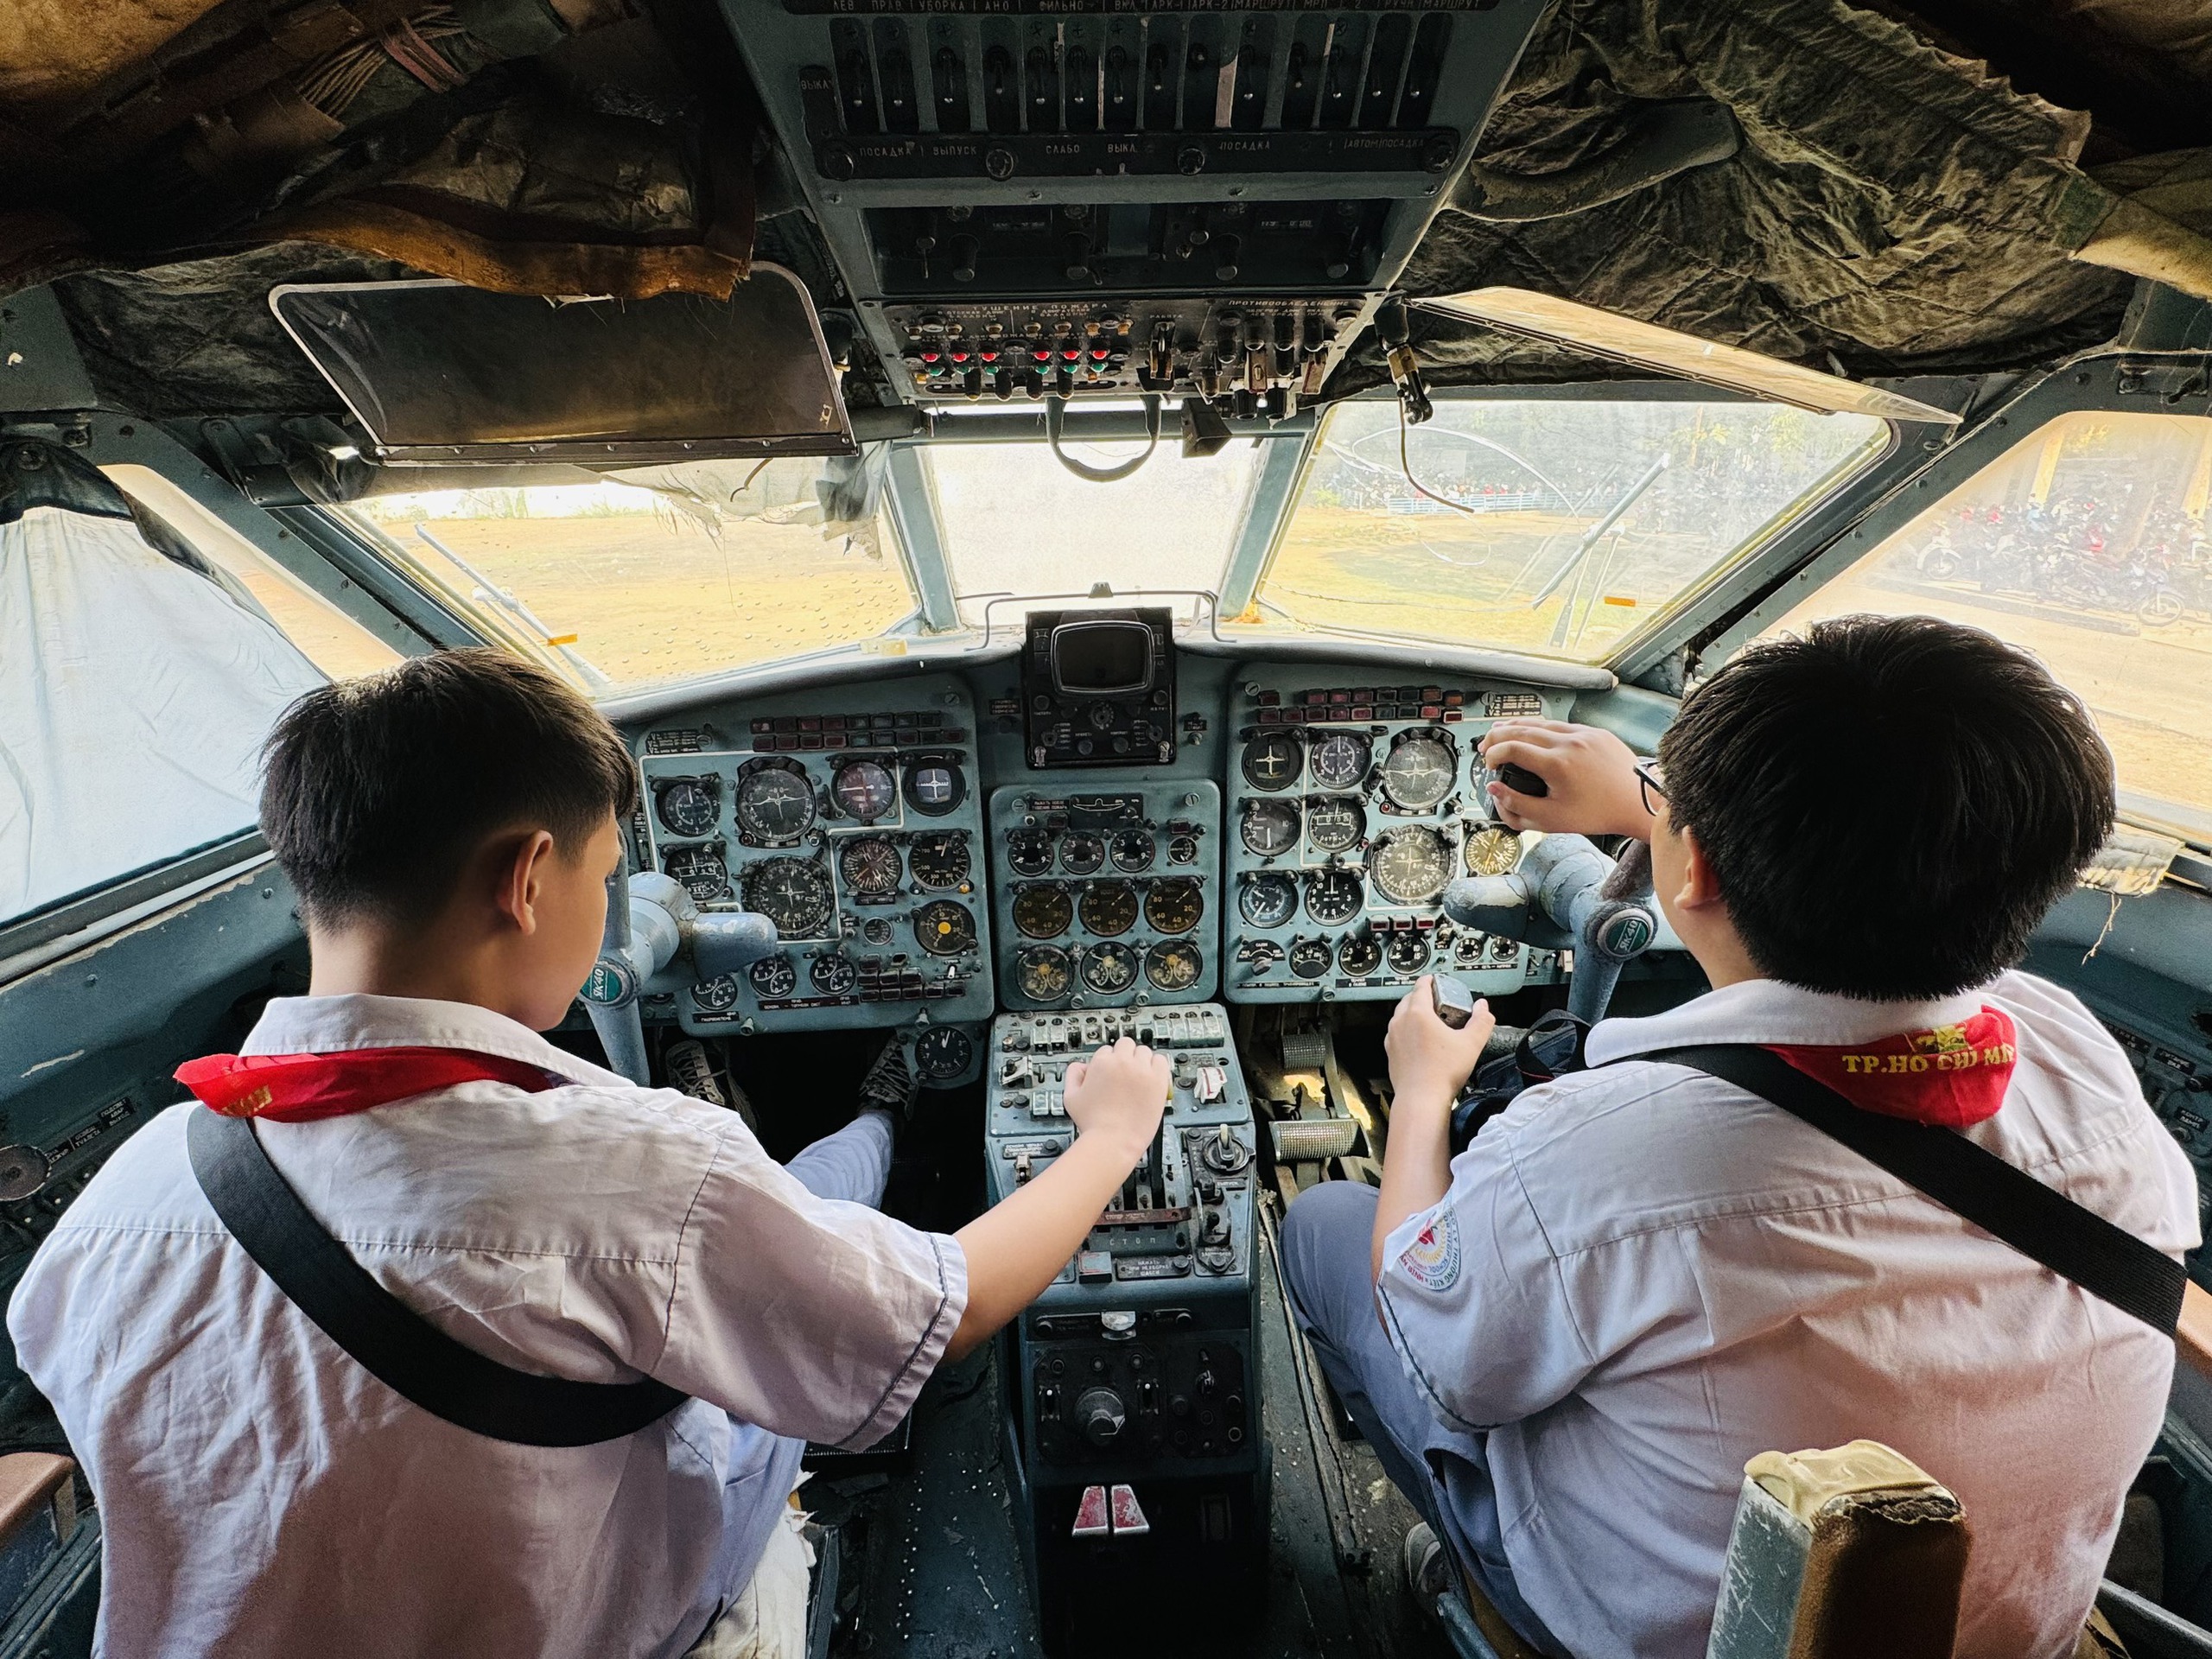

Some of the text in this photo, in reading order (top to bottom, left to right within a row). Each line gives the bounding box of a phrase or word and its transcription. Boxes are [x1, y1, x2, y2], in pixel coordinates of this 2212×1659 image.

[918, 0, 965, 10] УБОРКА
[985, 0, 1010, 10] АНО
[1039, 0, 1084, 10] СИЛЬНО
[860, 145, 912, 157] ПОСАДКА
[933, 146, 976, 156] ВЫПУСК
[1046, 144, 1080, 155] СЛАБО
[1219, 141, 1271, 151] ПОСАДКА
[1281, 819, 1289, 828] 10
[1036, 841, 1042, 849] 6
[1120, 838, 1125, 847] 3
[1346, 893, 1352, 902] 3
[1184, 904, 1193, 912] 20
[1109, 1236, 1156, 1246] СТОП
